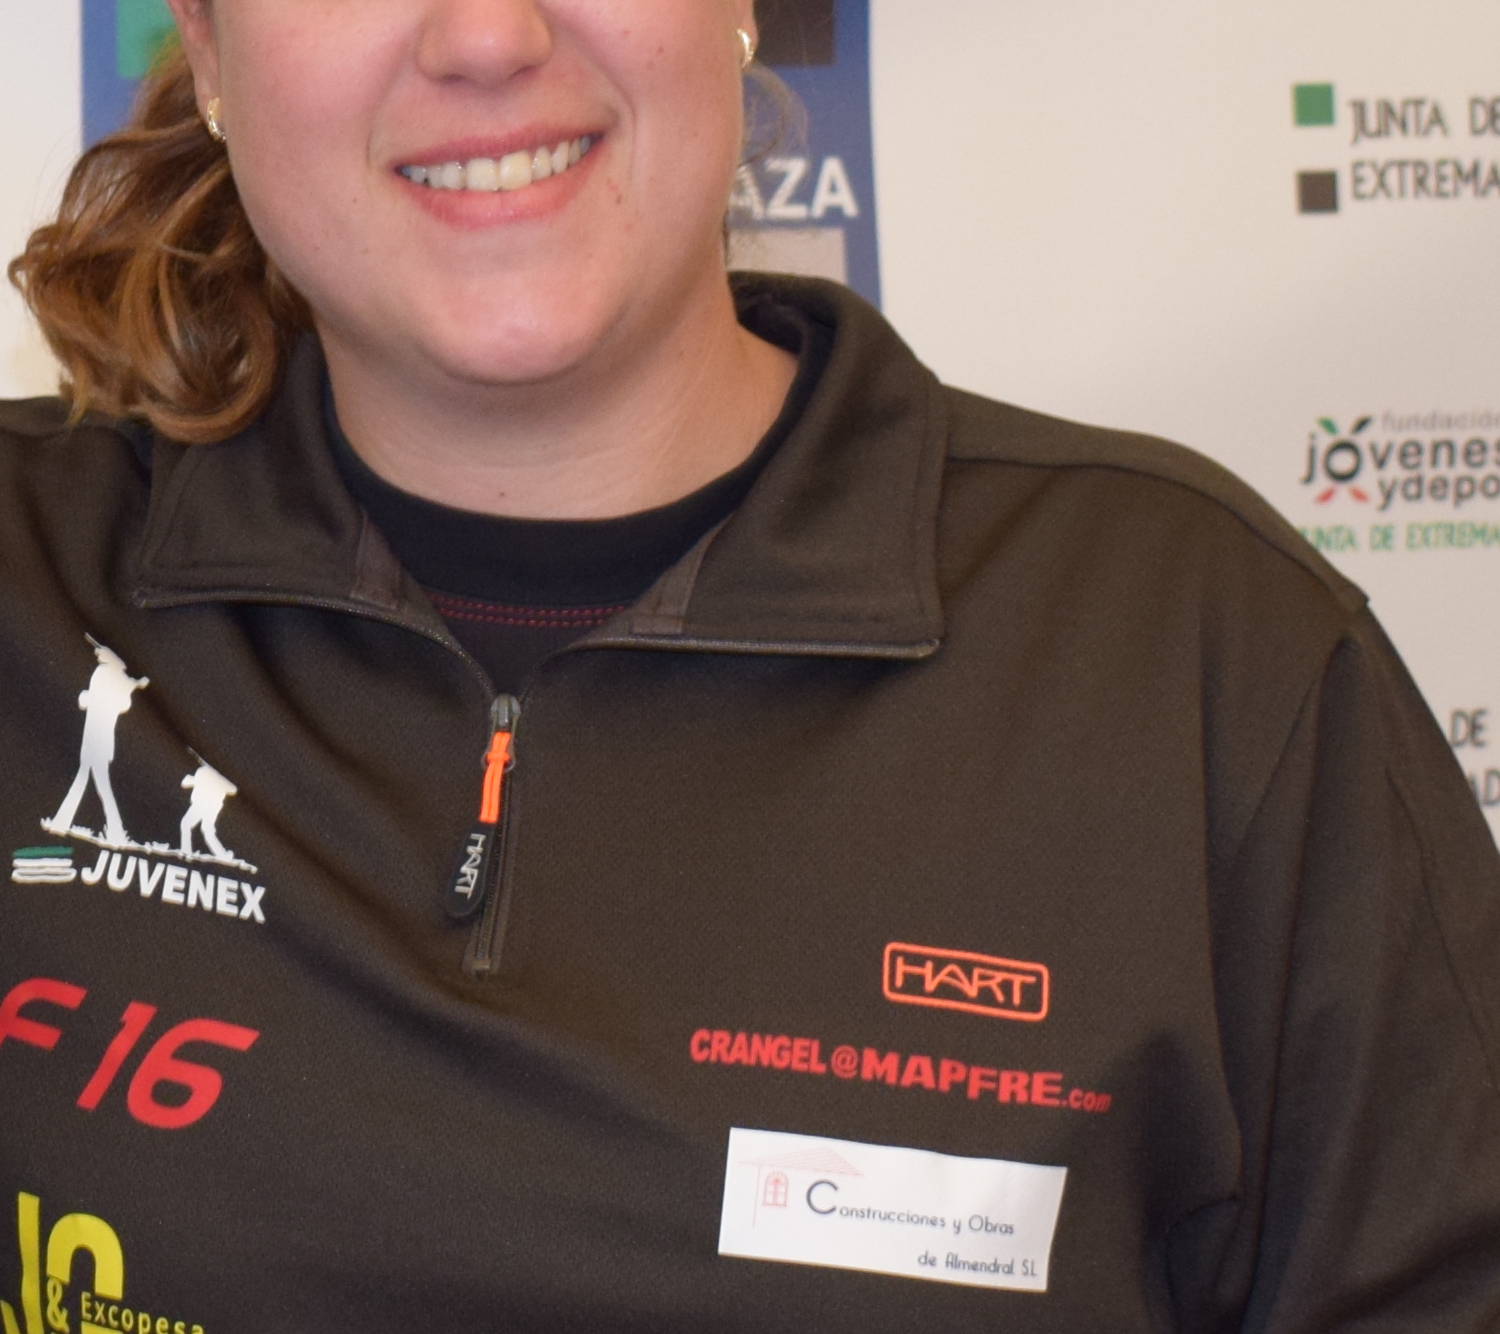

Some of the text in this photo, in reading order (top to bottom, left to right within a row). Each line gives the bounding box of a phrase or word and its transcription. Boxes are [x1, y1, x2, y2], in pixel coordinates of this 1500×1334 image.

[1349, 96, 1450, 145] JUNTA
[1368, 524, 1396, 551] DE
[1450, 707, 1489, 749] DE
[81, 849, 267, 925] JUVENEX
[453, 832, 486, 900] HART
[895, 956, 1037, 1008] HART
[805, 1179, 1015, 1236] Construcciones y Obras
[917, 1250, 938, 1268] de
[945, 1252, 1016, 1277] Almendral
